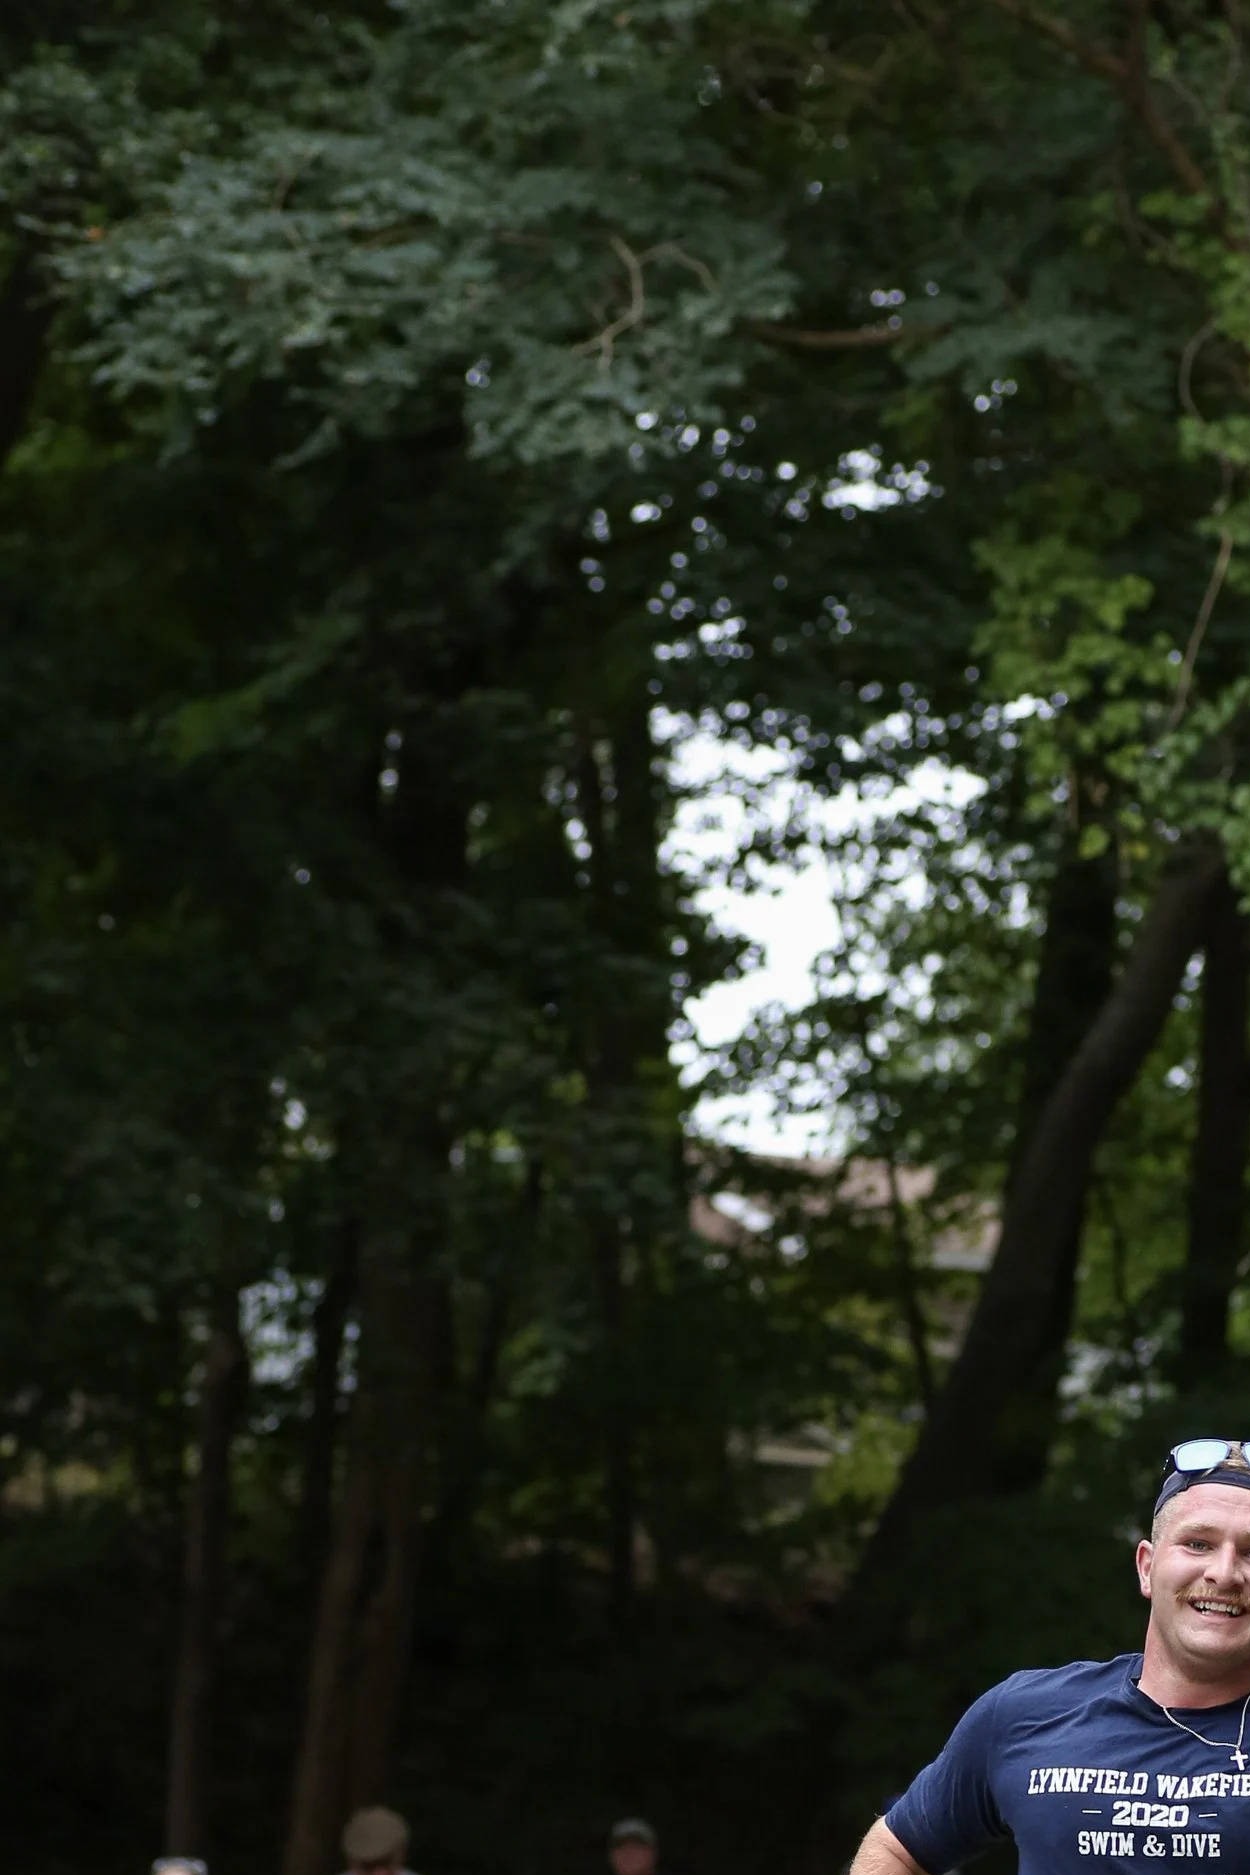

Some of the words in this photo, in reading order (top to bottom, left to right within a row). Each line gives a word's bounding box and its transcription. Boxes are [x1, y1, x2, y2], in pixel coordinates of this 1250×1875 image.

[1028, 1768, 1148, 1795] LYNNFIELD
[1112, 1801, 1189, 1827] 2020
[1078, 1831, 1135, 1856] SWIM
[1143, 1834, 1166, 1857] &
[1172, 1833, 1221, 1857] DIVE
